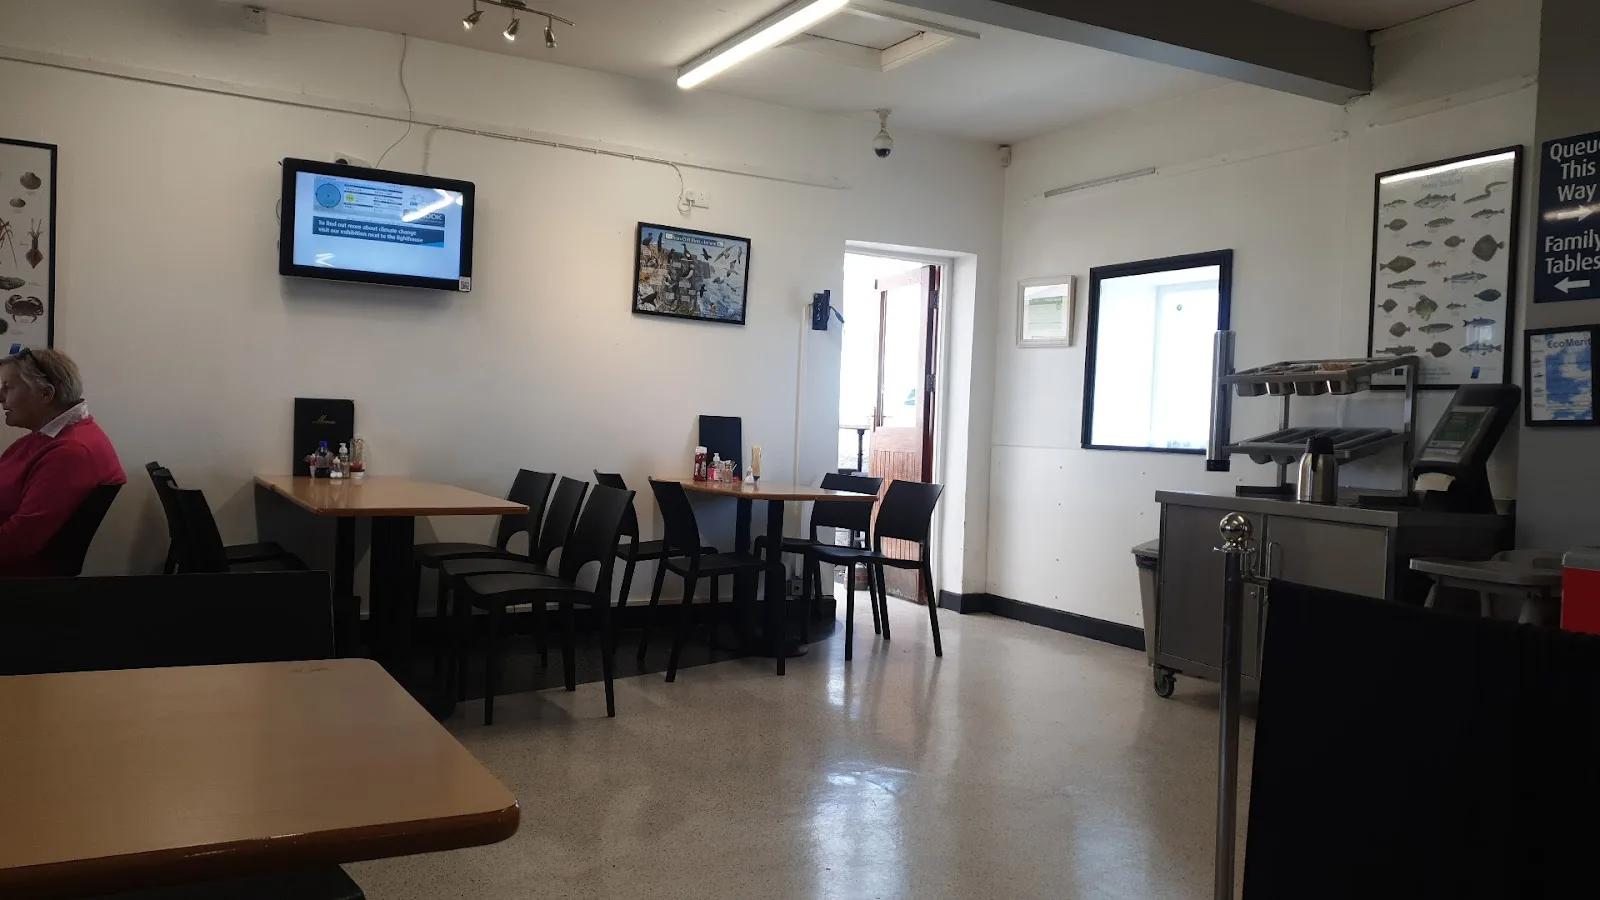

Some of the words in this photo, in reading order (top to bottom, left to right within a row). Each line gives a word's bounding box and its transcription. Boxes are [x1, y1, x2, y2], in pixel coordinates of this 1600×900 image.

[1549, 139, 1600, 163] Queu
[1560, 158, 1596, 180] This
[1557, 183, 1597, 203] Way
[340, 229, 367, 237] exhibition
[396, 235, 424, 244] lighthouse
[378, 226, 397, 234] climate
[398, 229, 417, 237] change
[1545, 228, 1600, 253] Family
[1545, 252, 1600, 275] Tables
